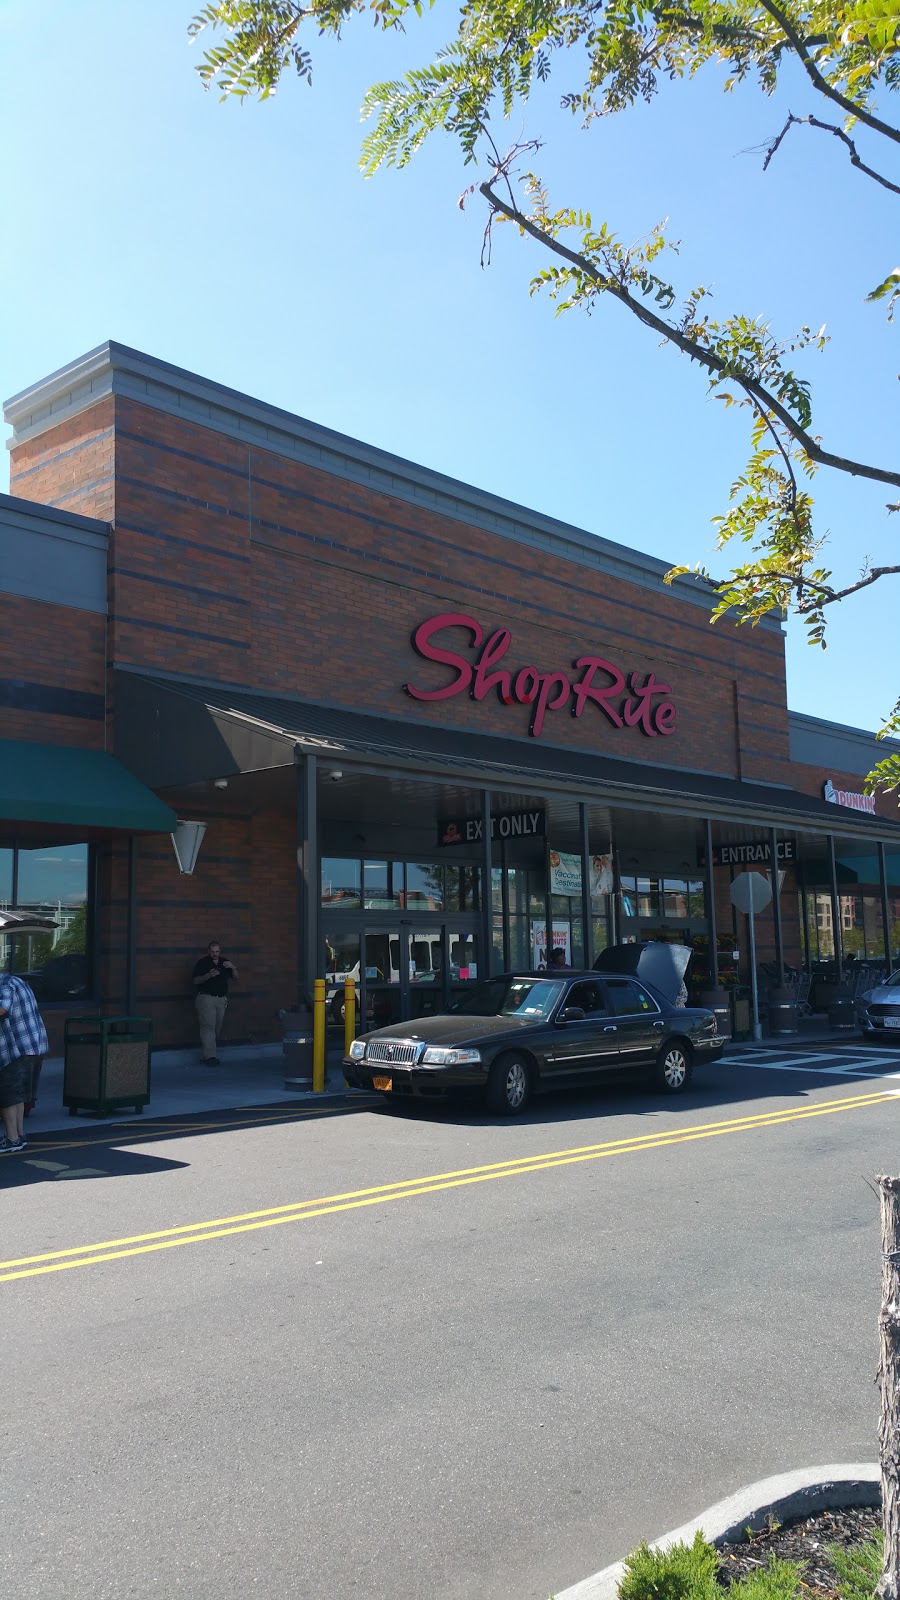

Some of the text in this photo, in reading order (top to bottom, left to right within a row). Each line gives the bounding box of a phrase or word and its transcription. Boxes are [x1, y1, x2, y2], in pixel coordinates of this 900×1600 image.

[404, 613, 677, 737] ShopRite
[466, 818, 497, 841] EXT
[499, 812, 539, 837] ONLY
[721, 841, 793, 863] ENTRANCE
